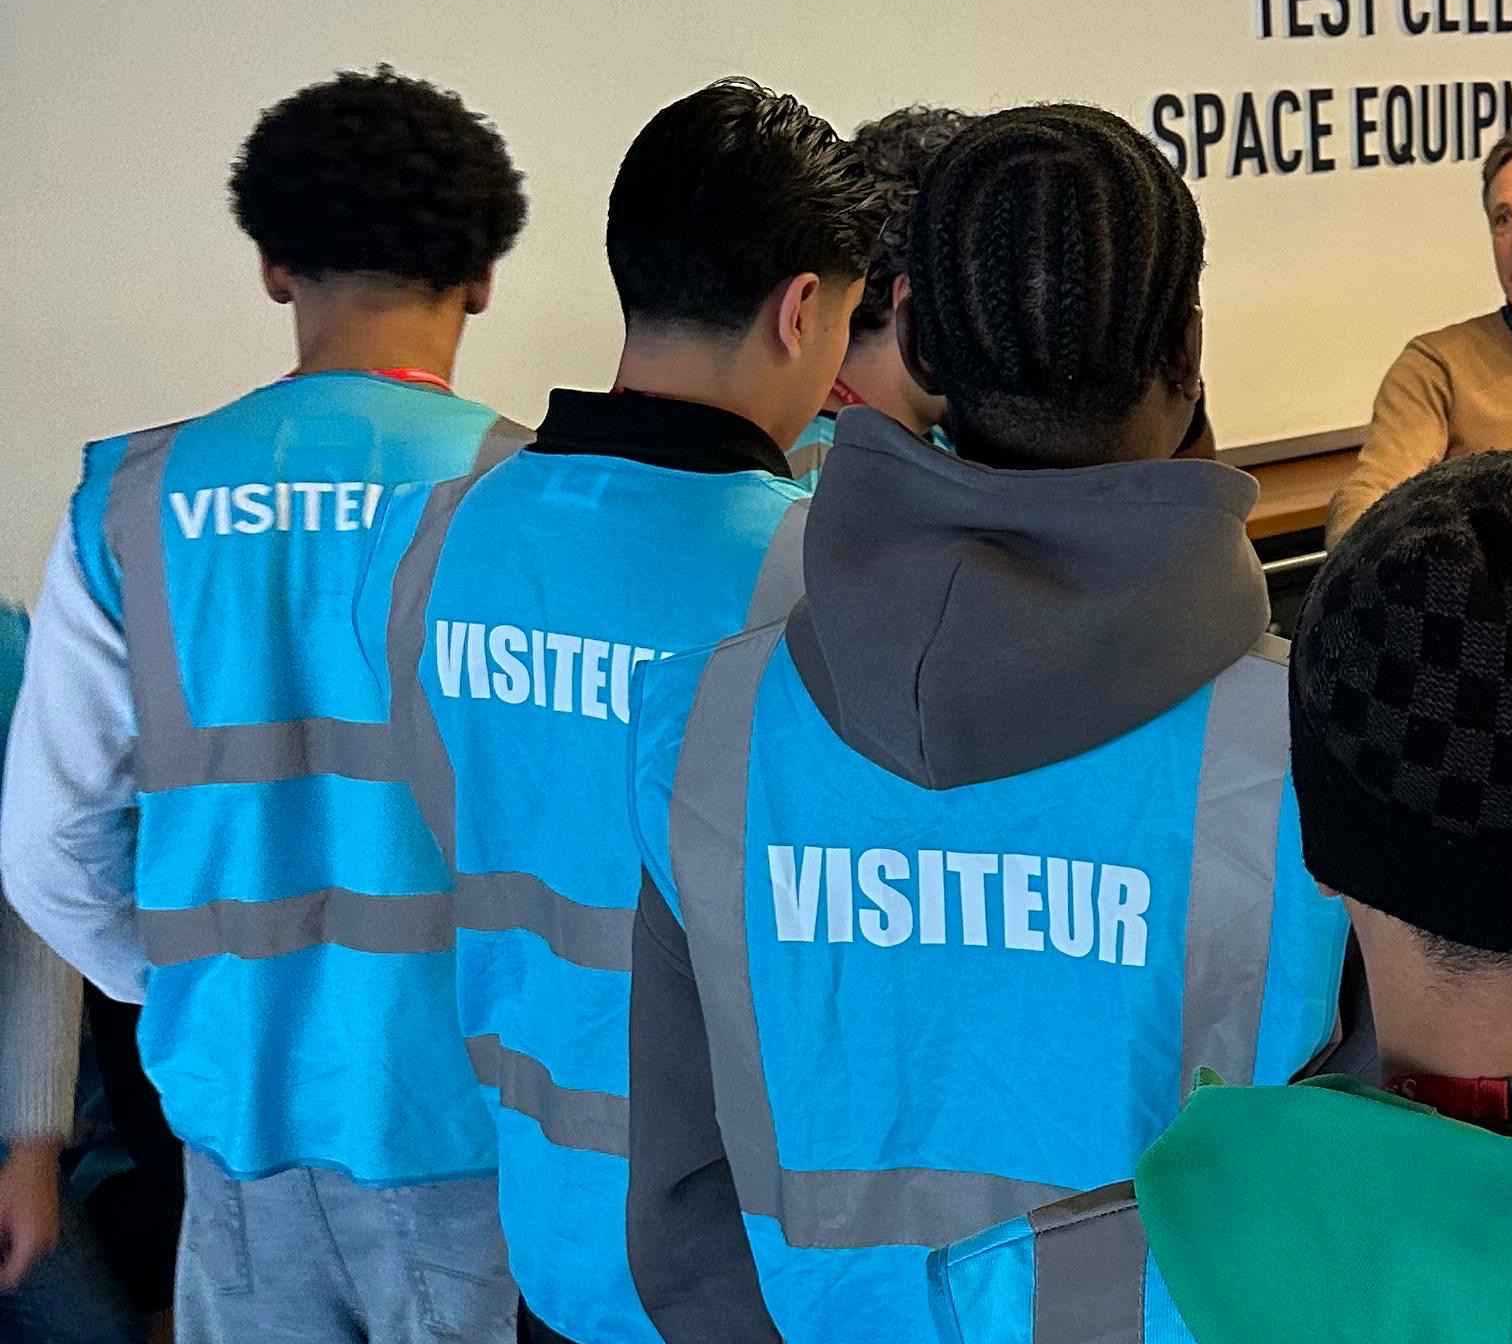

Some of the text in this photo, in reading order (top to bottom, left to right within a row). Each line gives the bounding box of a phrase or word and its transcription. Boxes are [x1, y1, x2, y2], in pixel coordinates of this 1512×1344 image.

[1152, 88, 1336, 179] SPACE
[436, 619, 676, 725] VISITEU
[767, 844, 1152, 968] VISITEUR
